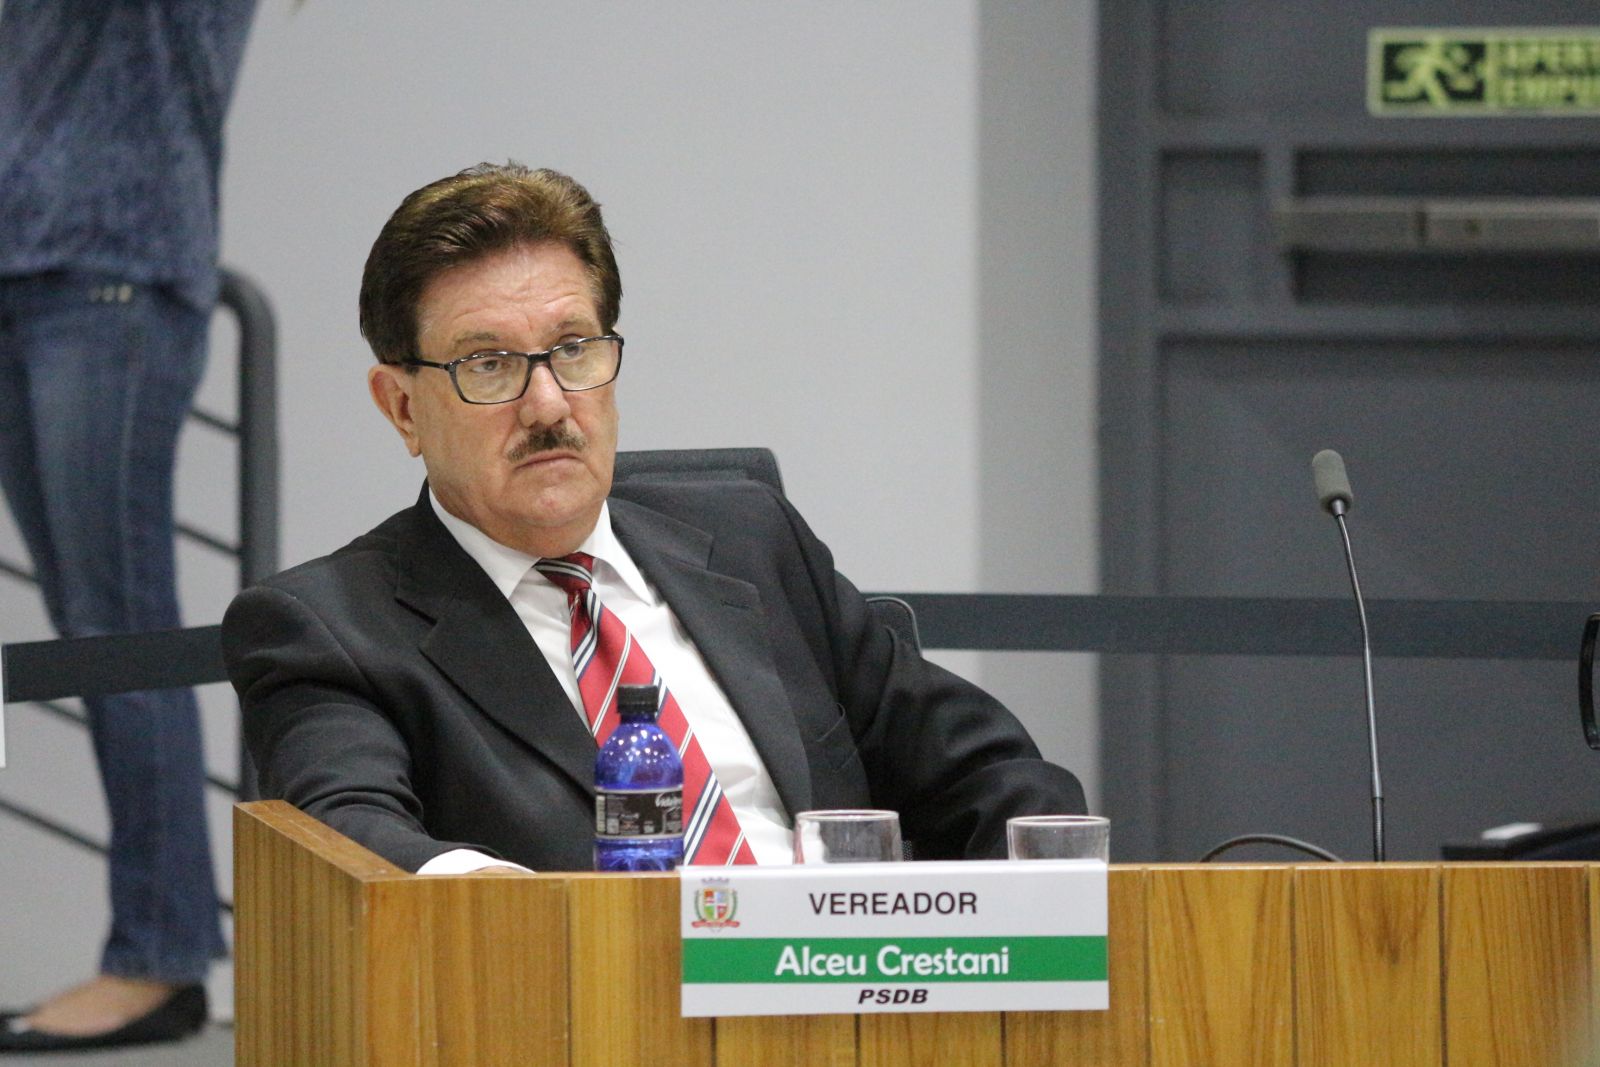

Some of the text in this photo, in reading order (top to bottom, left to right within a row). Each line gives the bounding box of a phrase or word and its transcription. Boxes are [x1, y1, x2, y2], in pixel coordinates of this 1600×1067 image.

[808, 892, 978, 915] VEREADOR
[775, 944, 1009, 976] Alceu Crestani
[858, 989, 929, 1005] PSDB
